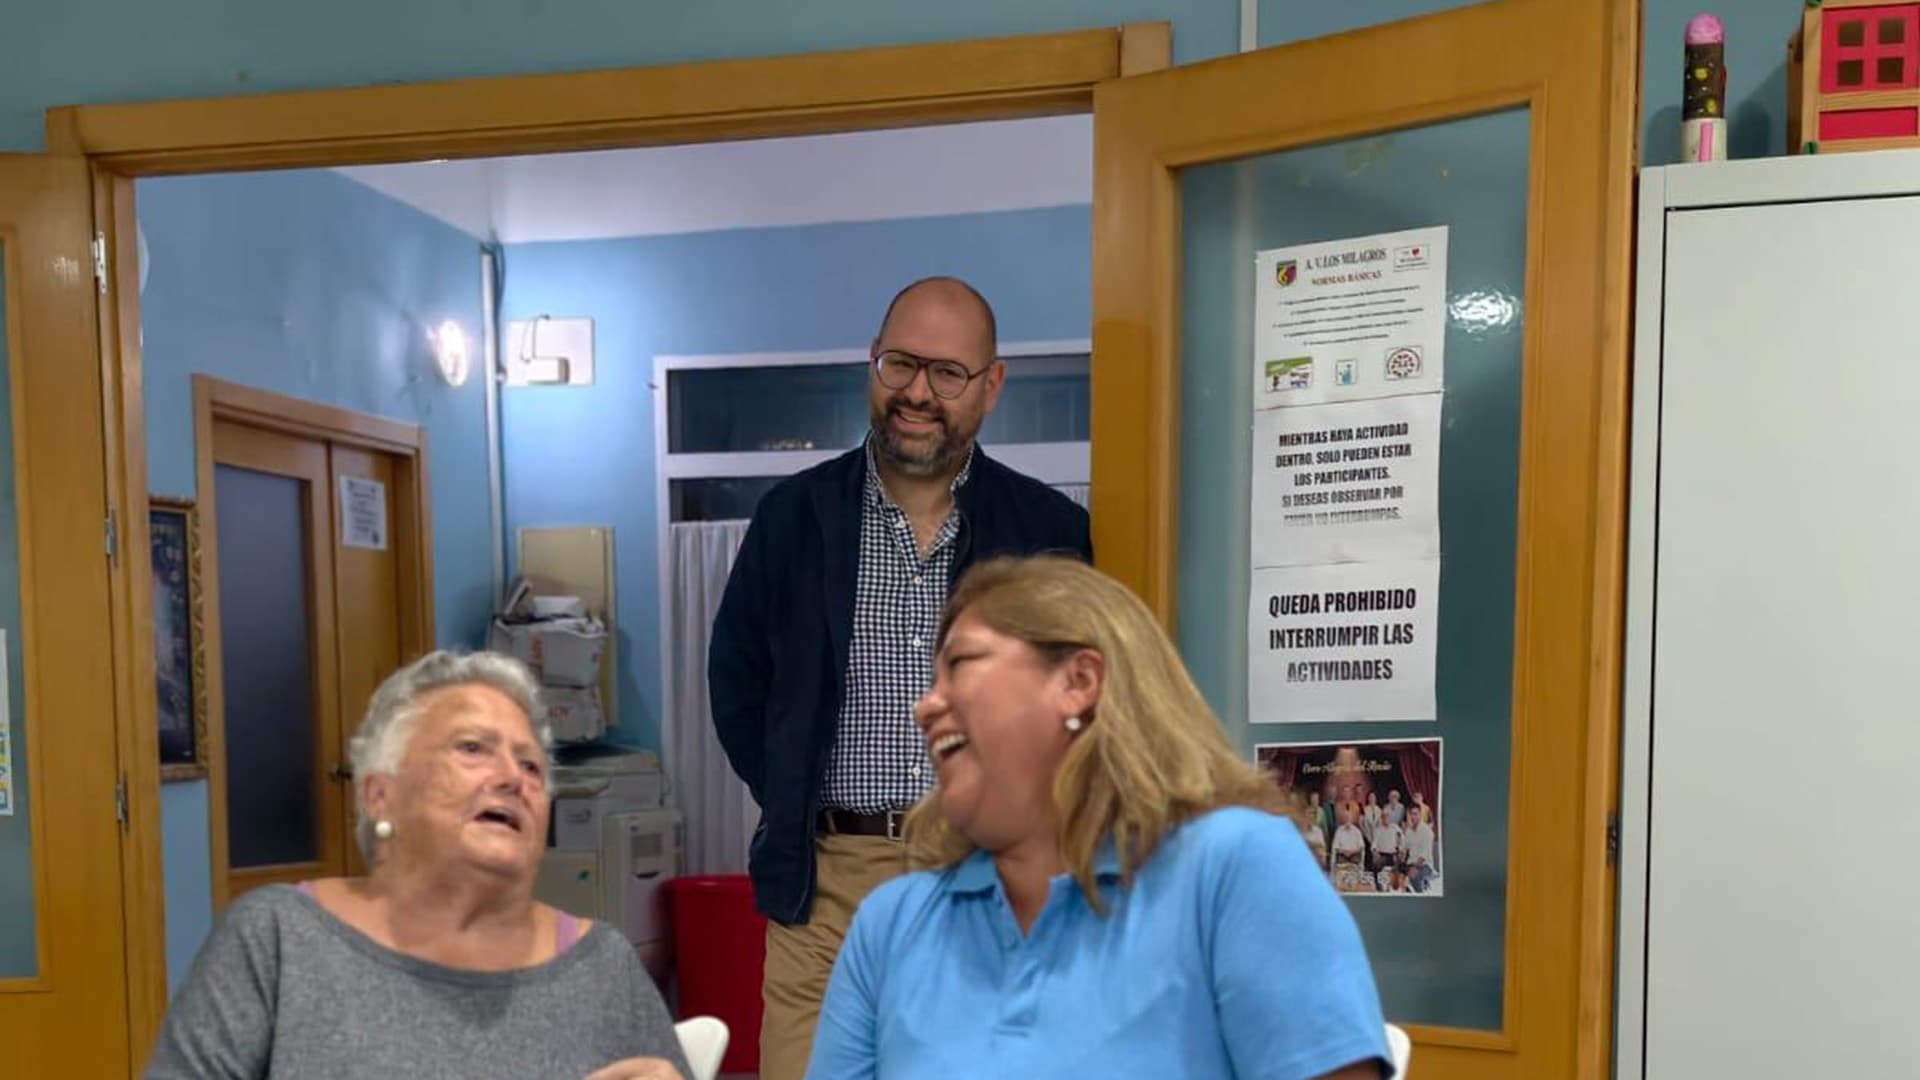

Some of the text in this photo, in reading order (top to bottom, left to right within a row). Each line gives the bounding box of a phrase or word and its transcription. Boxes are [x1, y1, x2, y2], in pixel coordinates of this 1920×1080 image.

[1278, 422, 1409, 448] MIENTRAS HAYA ACTIVIDAD
[1316, 449, 1341, 465] SOLO
[1342, 446, 1380, 462] PUEDEN
[1382, 443, 1412, 459] ESTAR
[1293, 466, 1391, 487] LOS PARTICIPANTES.
[1281, 485, 1404, 508] SI DESEAS OBSERVAR POR
[1268, 587, 1417, 618] QUEDA PROHIBIDO
[1269, 622, 1415, 650] INTERRUMPIR LAS
[1286, 658, 1394, 684] ACTIVIDADES
